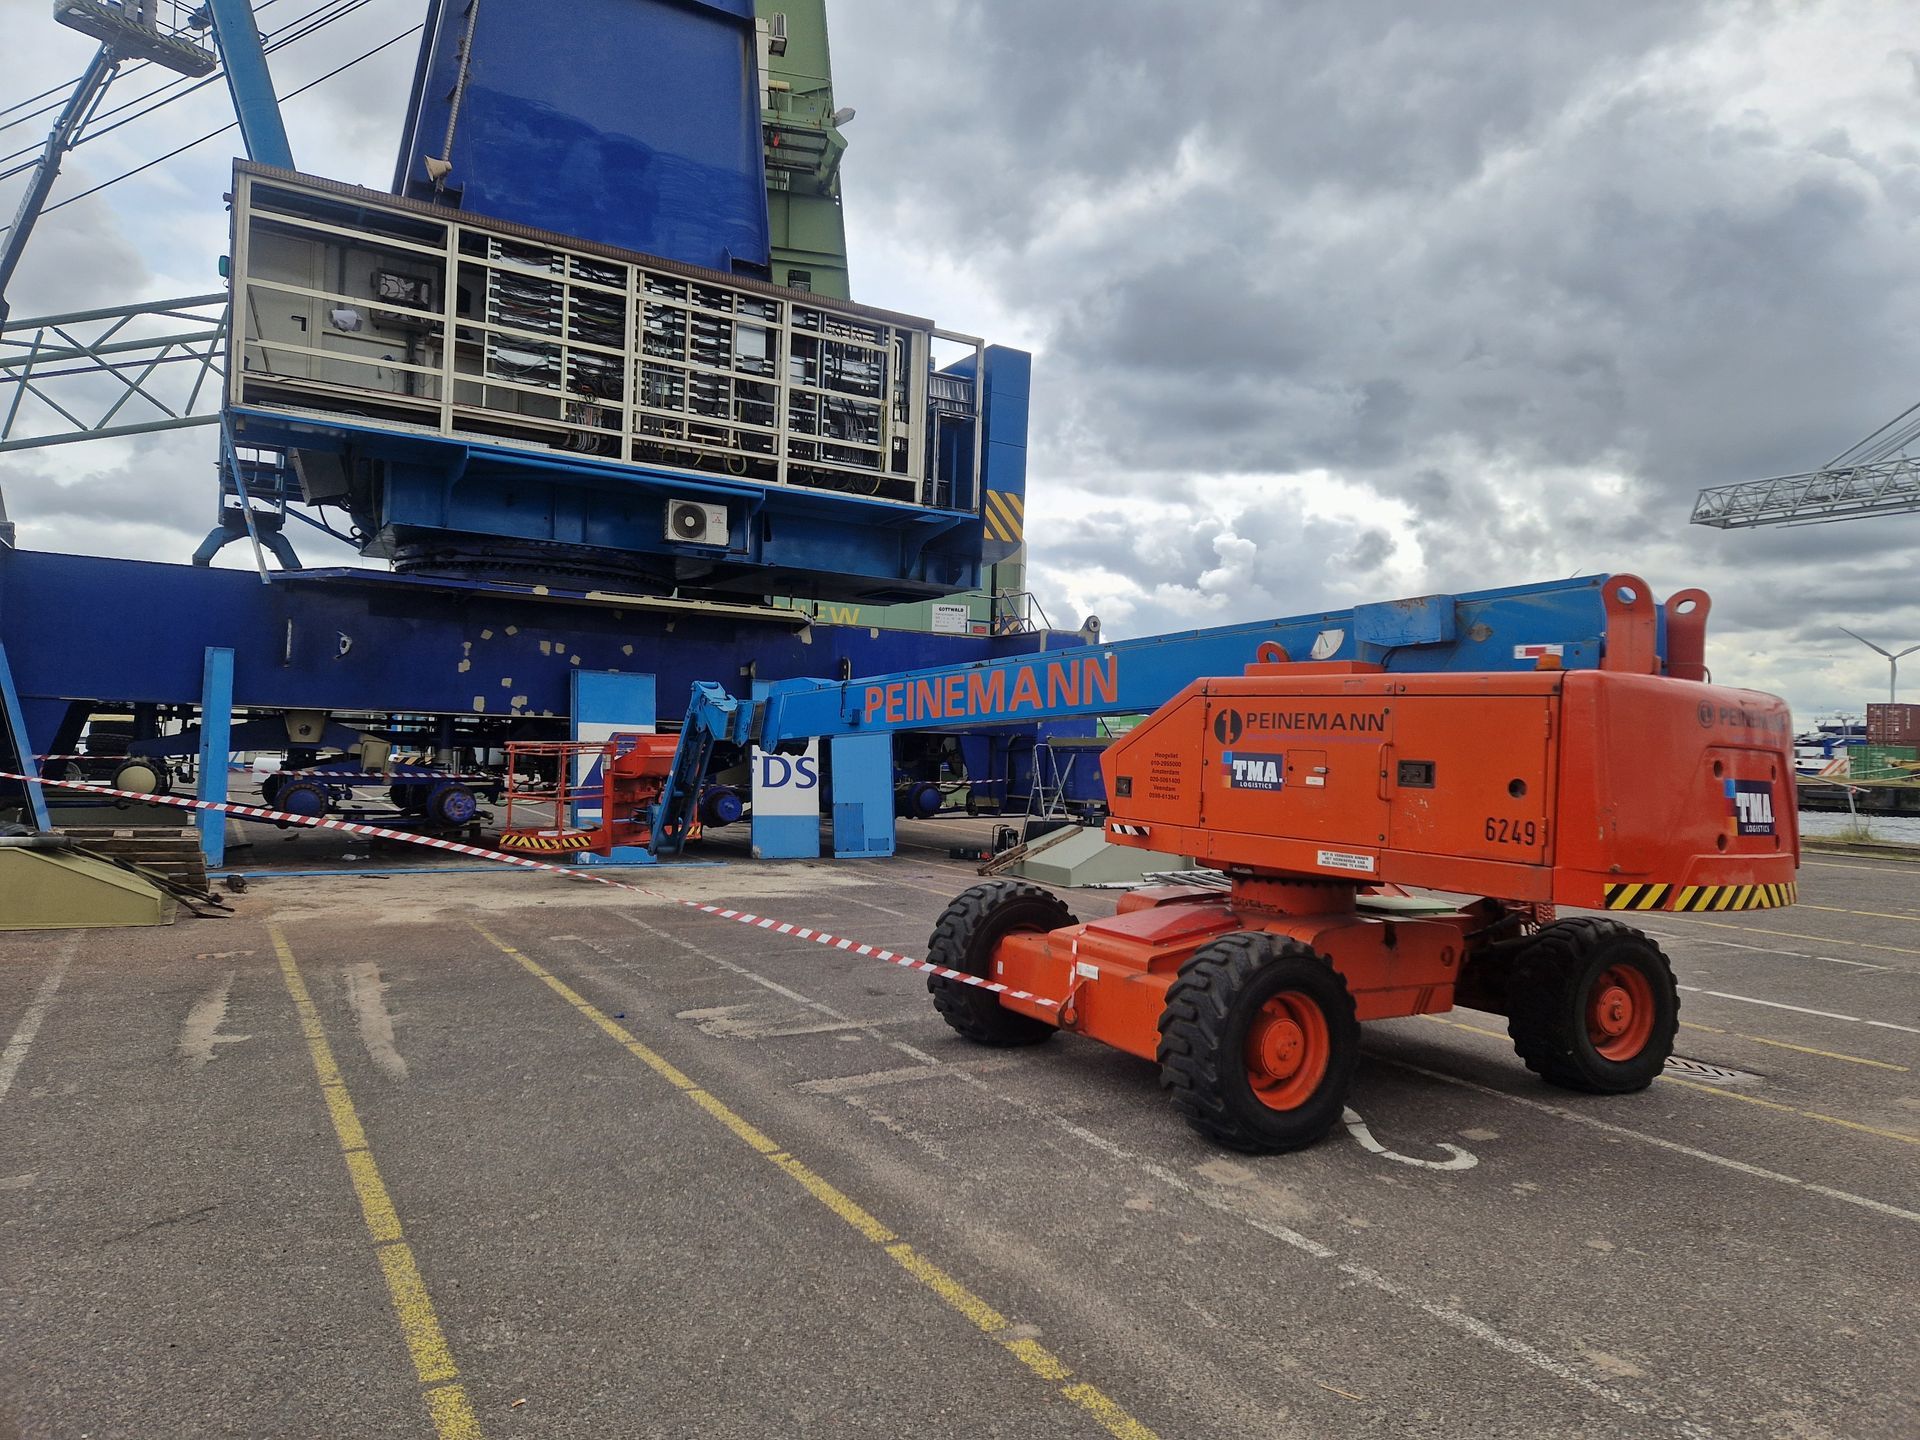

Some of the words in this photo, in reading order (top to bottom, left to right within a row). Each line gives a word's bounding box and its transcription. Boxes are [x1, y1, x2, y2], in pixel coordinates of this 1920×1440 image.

[864, 655, 1118, 724] PEINEMANN
[1246, 712, 1385, 732] PEINEMANN
[751, 756, 817, 789] DS
[1239, 781, 1272, 790] LOGISTICS
[1486, 817, 1535, 846] 6249
[1745, 824, 1770, 833] LOGISTICS
